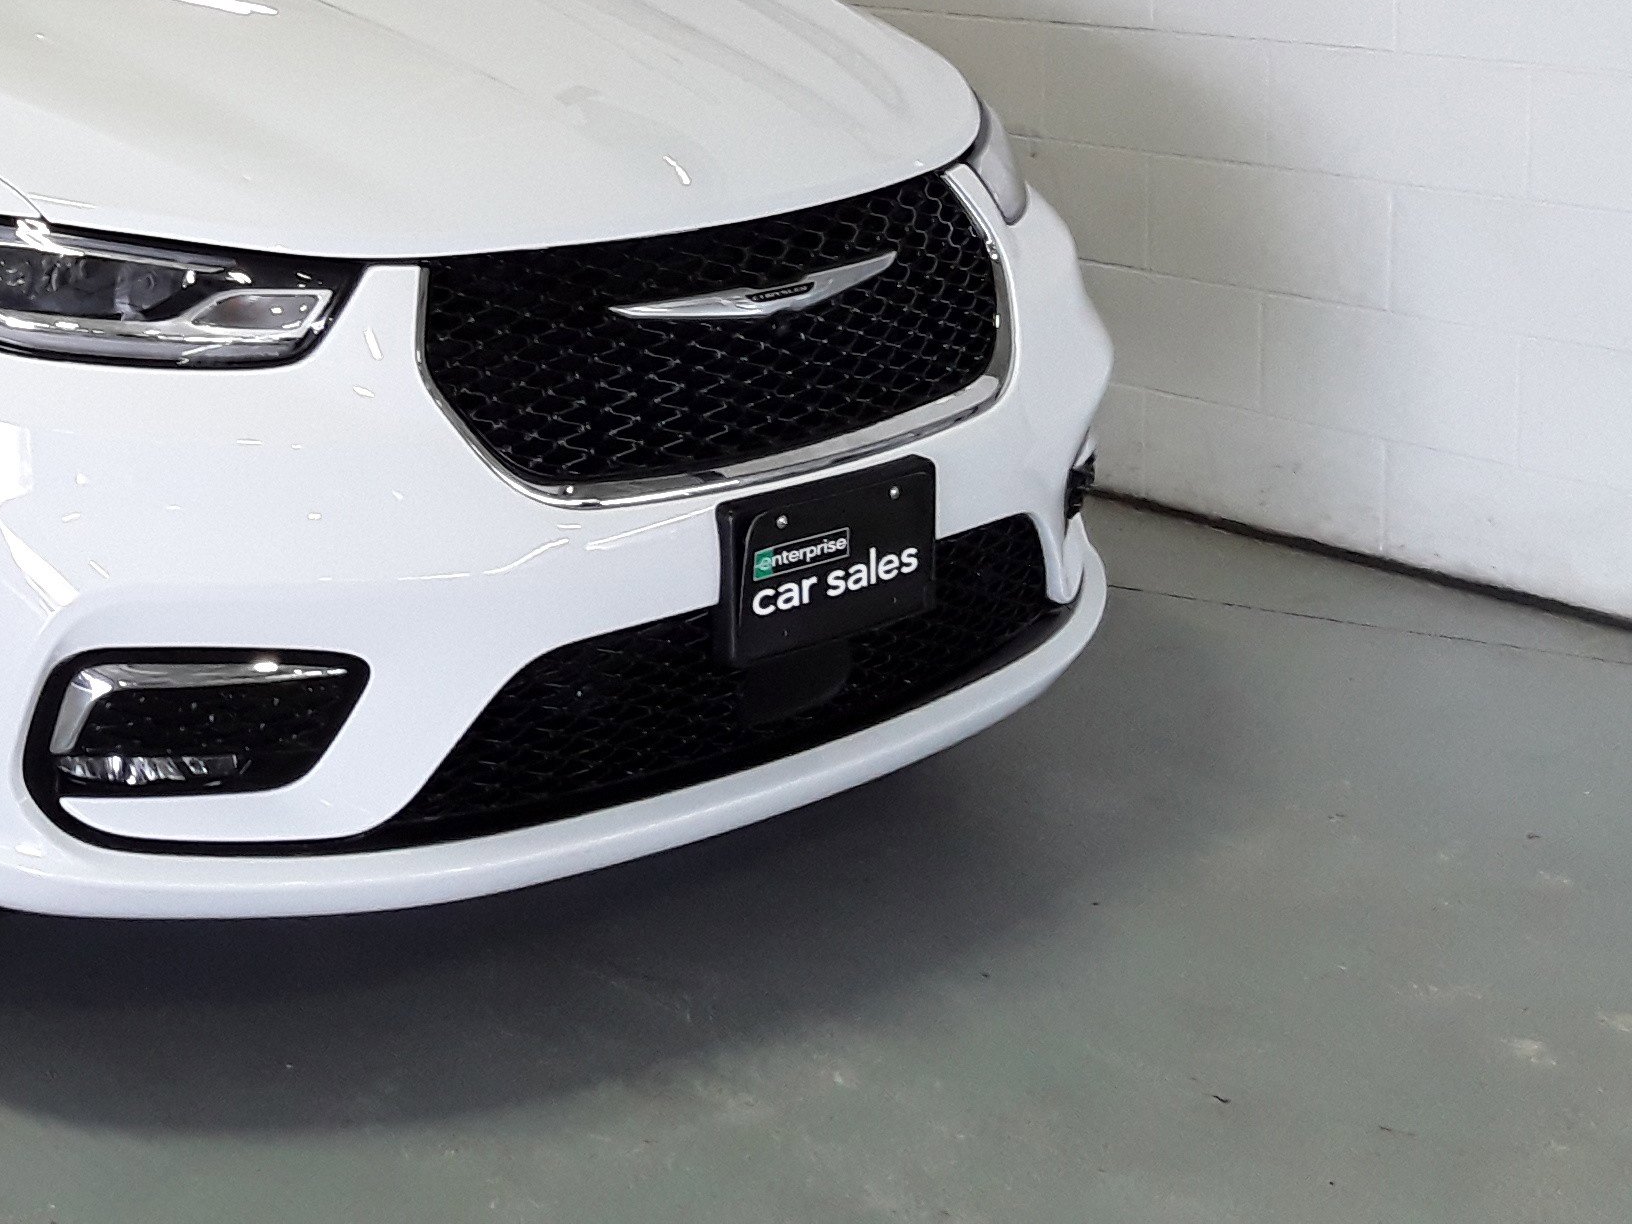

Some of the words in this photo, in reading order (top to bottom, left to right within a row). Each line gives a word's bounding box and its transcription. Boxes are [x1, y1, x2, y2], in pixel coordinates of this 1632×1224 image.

[755, 537, 847, 570] enterprise
[752, 577, 817, 616] car
[826, 547, 919, 597] sales
